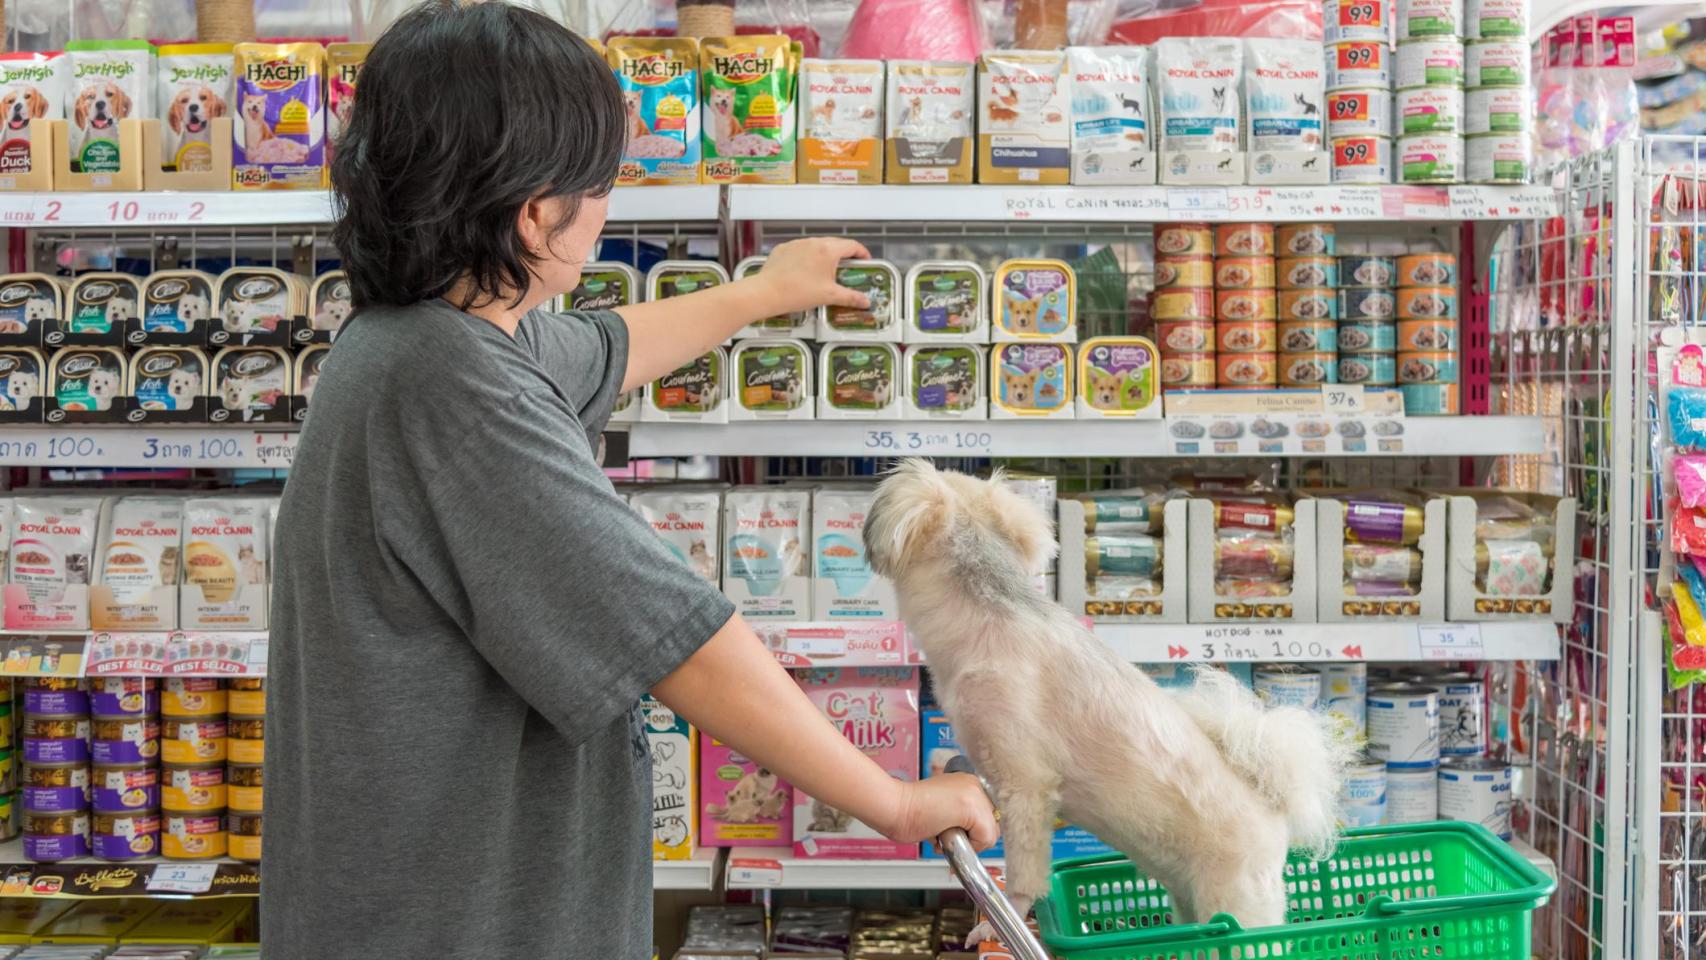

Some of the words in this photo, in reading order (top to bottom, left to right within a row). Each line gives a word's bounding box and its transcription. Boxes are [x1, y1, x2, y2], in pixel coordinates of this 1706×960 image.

[1350, 4, 1374, 21] 99
[1347, 48, 1372, 65] 99
[74, 61, 134, 78] JerHigh
[170, 64, 228, 82] JerHigh
[247, 63, 306, 82] HACHI
[623, 58, 683, 77] HACHI
[714, 57, 774, 75] HACHI
[1256, 69, 1284, 78] ROYAL
[1287, 69, 1319, 78] CANIN
[1168, 70, 1198, 79] ROYAL
[1201, 69, 1234, 78] CANIN
[810, 84, 839, 94] ROYAL
[842, 85, 872, 95] CANIN
[897, 86, 928, 95] ROYAL
[931, 86, 961, 96] CANIN
[1336, 99, 1359, 116] 99
[993, 148, 1038, 158] Chihuahua
[1344, 144, 1368, 161] 99
[1, 156, 31, 168] Duck
[235, 171, 270, 184] HACHI
[705, 164, 741, 177] HACHI
[45, 201, 62, 220] 2
[108, 201, 139, 220] 10
[188, 201, 206, 220] 2
[83, 283, 117, 300] Cesar
[150, 280, 187, 298] Cesar
[237, 277, 275, 296] Cesar
[923, 294, 973, 309] Gourmet
[62, 358, 96, 374] Cesar
[141, 357, 176, 375] Cesar
[236, 356, 273, 376] Cesar
[660, 373, 712, 387] Gourmet
[747, 369, 799, 386] Gourmet
[836, 368, 889, 385] Gourmet
[921, 369, 970, 387] Gourmet
[1328, 393, 1346, 405] 37
[143, 438, 159, 458] 3
[907, 433, 922, 449] 3
[20, 524, 50, 533] ROYAL
[52, 526, 81, 535] CANIN
[192, 526, 222, 535] ROYAL
[223, 526, 253, 535] CANIN
[673, 521, 704, 531] CANIN
[768, 519, 798, 528] CANIN
[826, 519, 856, 529] ROYAL
[116, 528, 146, 536] ROYAL
[147, 528, 177, 536] CANIN
[1439, 633, 1454, 643] 35
[1201, 644, 1215, 659] 3
[97, 661, 124, 672] BEST
[126, 661, 163, 672] SELLER
[173, 660, 200, 672] BEST
[202, 660, 239, 672] SELLER
[171, 871, 186, 879] 23
